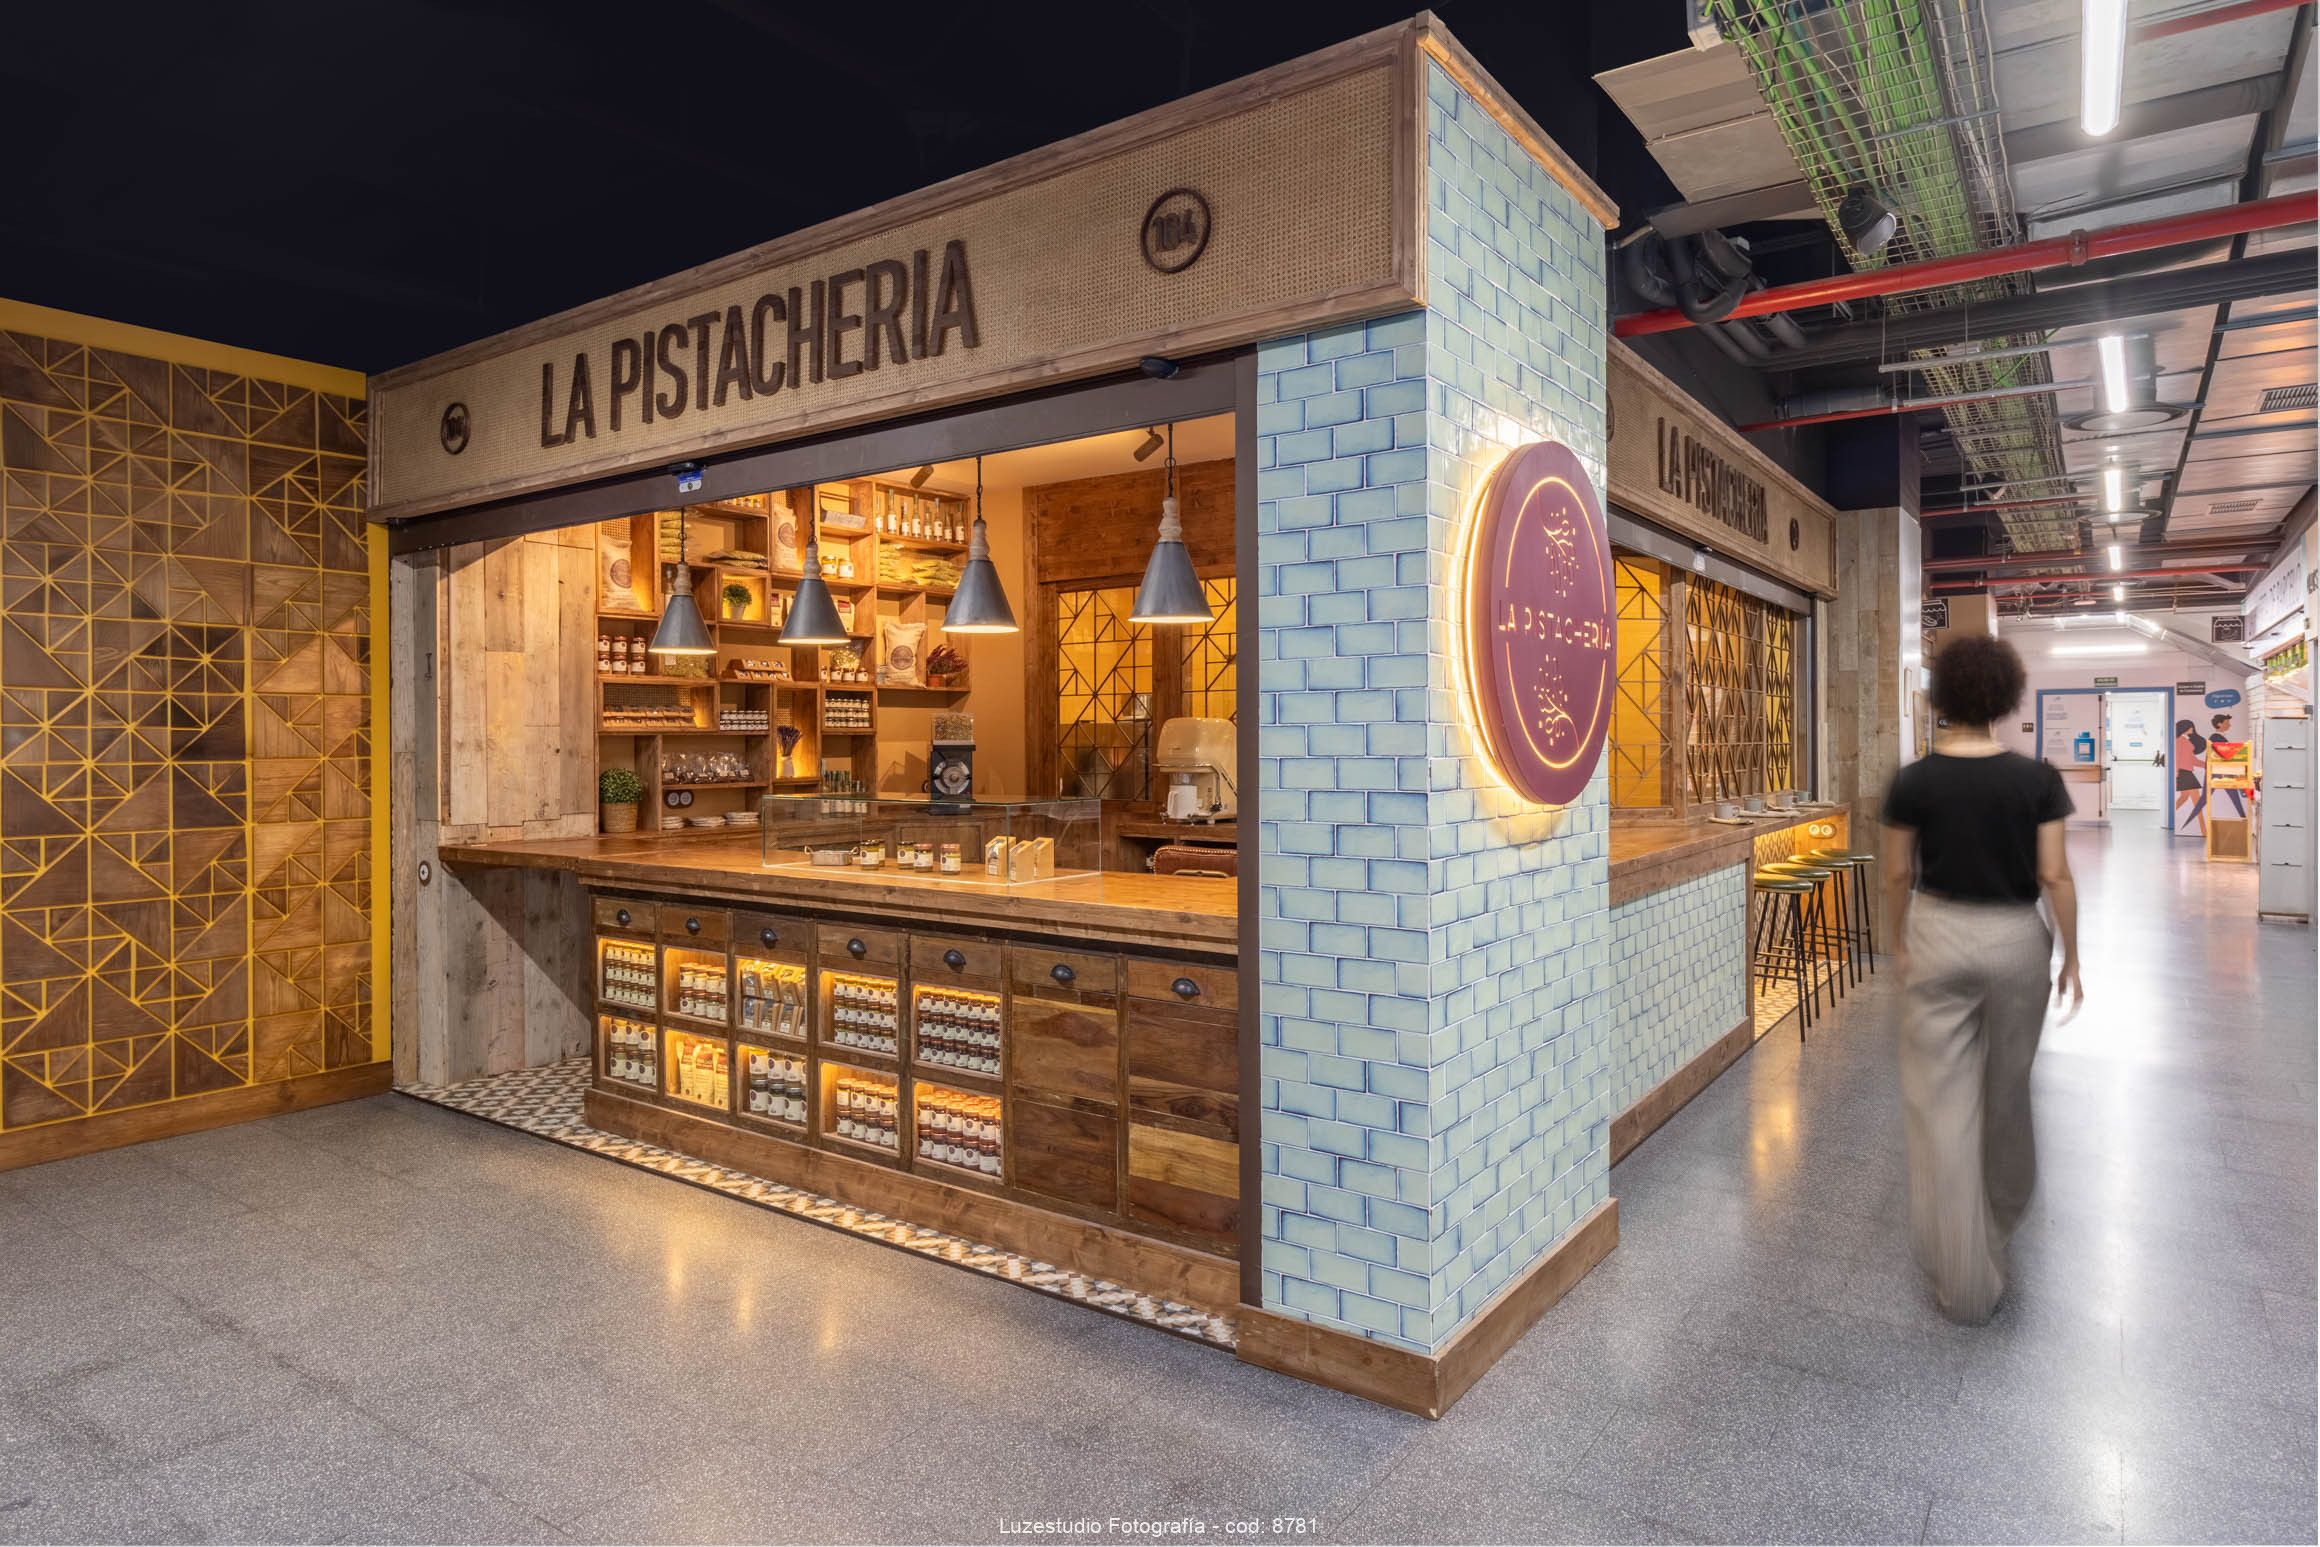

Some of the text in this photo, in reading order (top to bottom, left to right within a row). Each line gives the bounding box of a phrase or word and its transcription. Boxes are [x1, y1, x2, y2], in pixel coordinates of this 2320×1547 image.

[541, 239, 979, 448] LA PISTACHERIA
[1658, 416, 1769, 545] LA PISTACHERIA
[1498, 602, 1517, 632] LA
